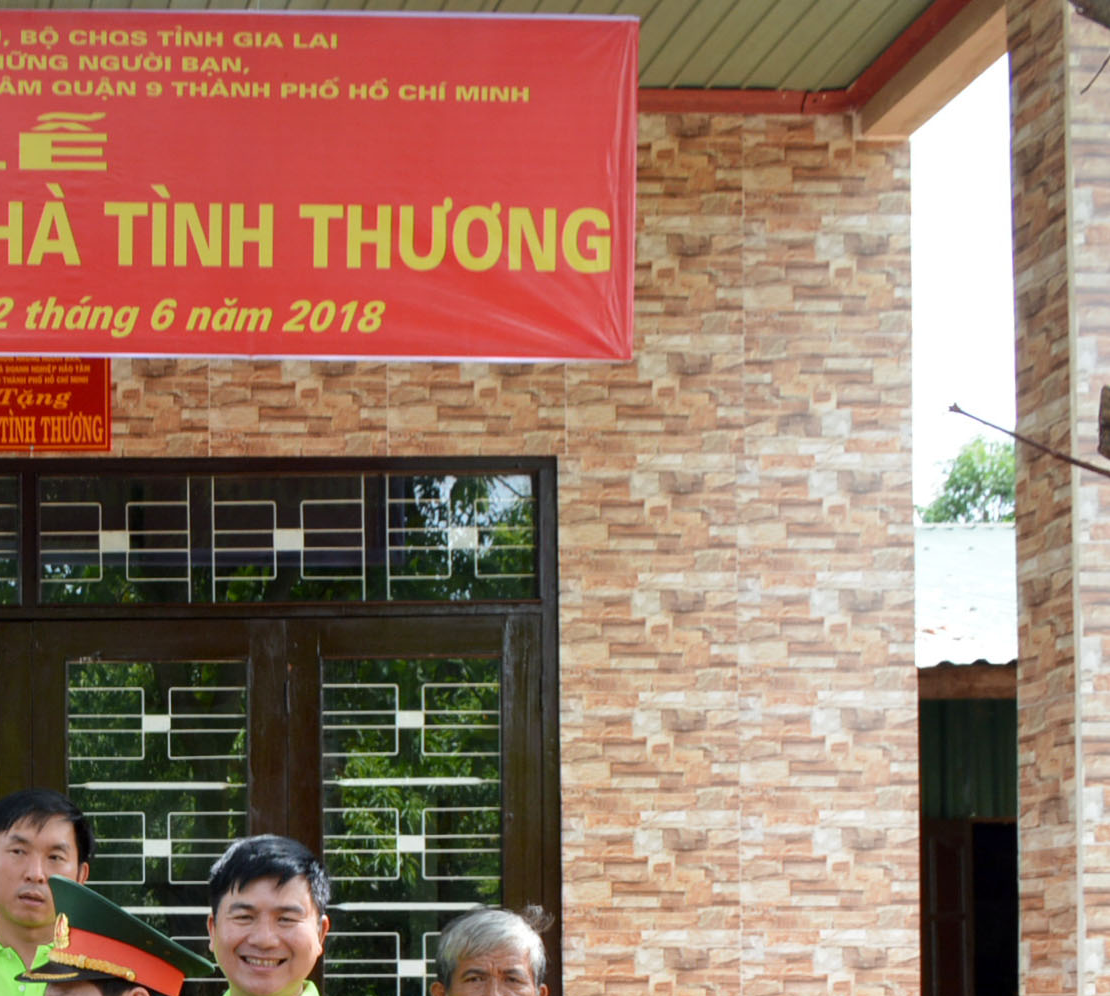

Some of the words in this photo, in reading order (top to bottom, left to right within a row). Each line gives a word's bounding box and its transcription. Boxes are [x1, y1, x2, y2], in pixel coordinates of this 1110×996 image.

[21, 25, 59, 49] BỘ
[69, 30, 148, 46] CHQS
[158, 26, 224, 47] TỈNH
[233, 32, 284, 48] GIA
[294, 33, 338, 49] LAI
[79, 52, 172, 71] NGƯỜI
[182, 57, 249, 76] BẠN,
[52, 77, 137, 100] QUẬN
[146, 82, 163, 97] 9
[171, 78, 271, 98] THÀNH
[281, 77, 340, 98] PHỐ
[398, 82, 447, 101] CHÍ
[456, 86, 530, 102] MINH
[104, 183, 275, 268] TÌNH
[299, 197, 612, 273] THƯƠNG
[25, 296, 139, 338] tháng
[151, 299, 178, 331] 6
[186, 297, 273, 332] năm
[282, 299, 387, 333] 2018
[40, 410, 104, 444] THƯƠNG
